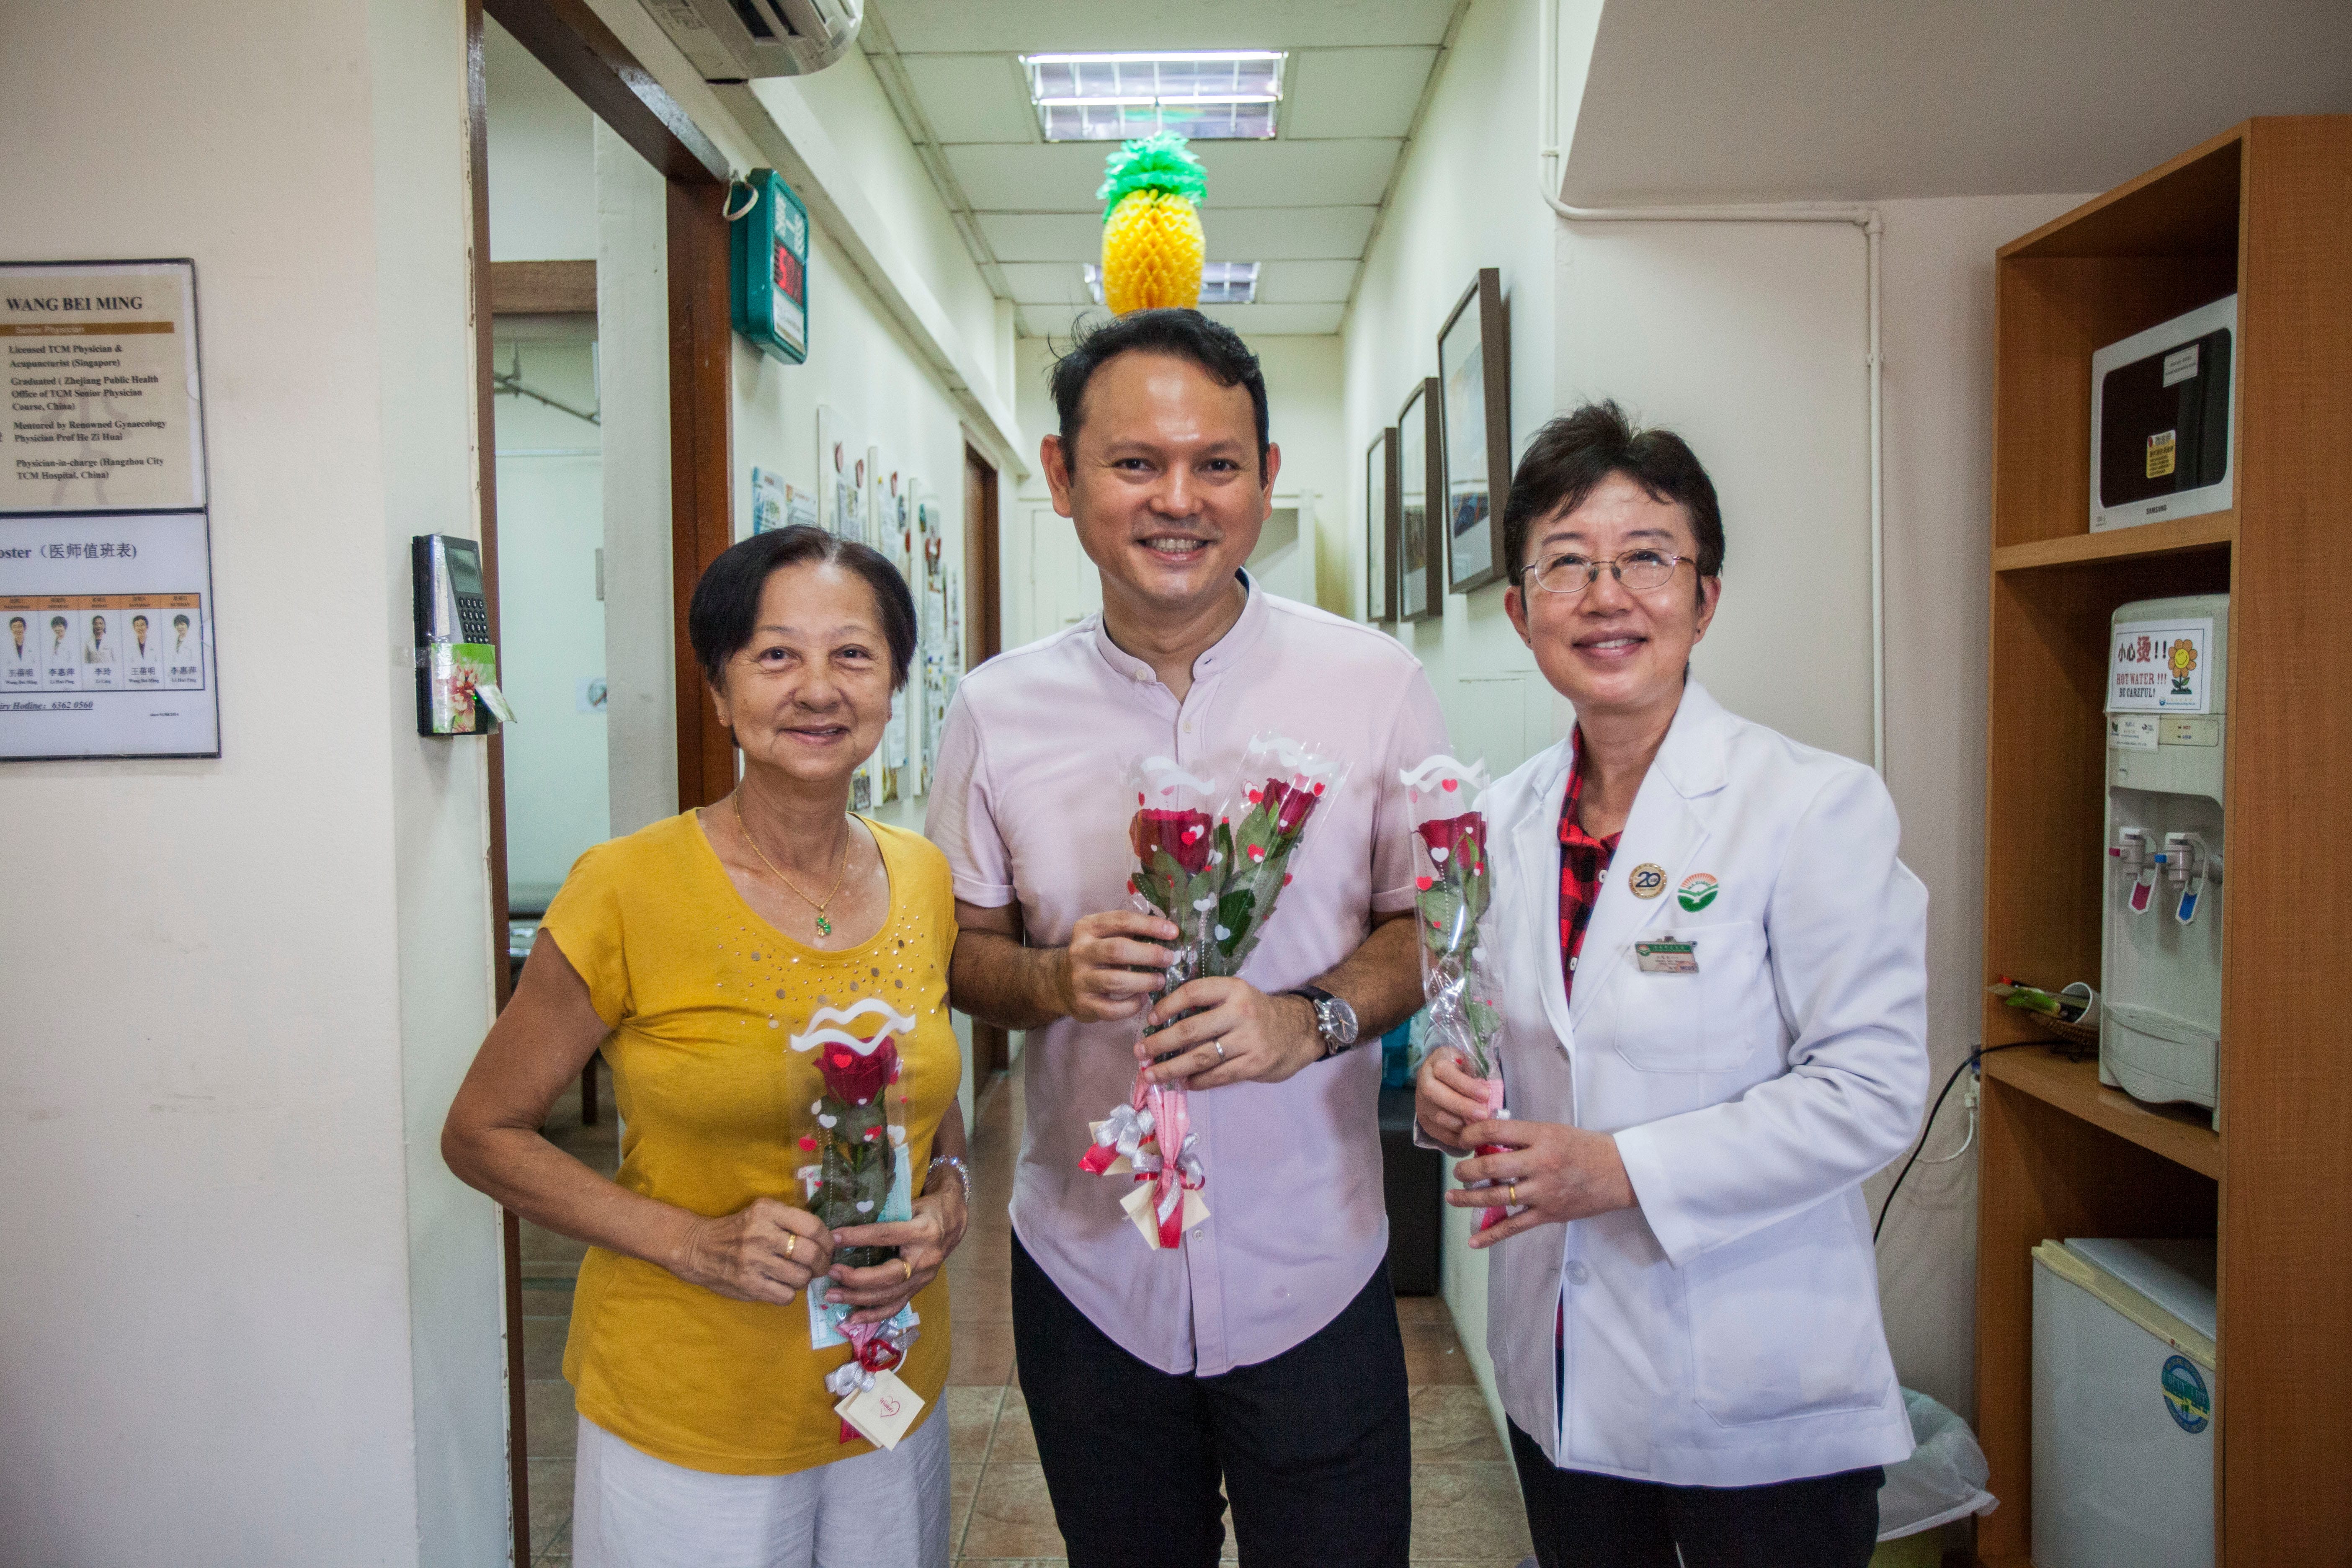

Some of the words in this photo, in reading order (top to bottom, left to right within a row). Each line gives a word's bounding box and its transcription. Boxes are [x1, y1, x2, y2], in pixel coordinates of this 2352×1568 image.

[6, 298, 58, 311] WANG
[63, 297, 91, 311] BEI
[97, 296, 142, 310] MING
[72, 345, 112, 355] Physician
[10, 359, 69, 369] Acupuncturist
[72, 359, 120, 369] (Singapore)
[64, 377, 101, 386] Zhejiang
[104, 388, 142, 398] Physician
[46, 402, 75, 410] China)
[13, 421, 54, 430] Mentored
[57, 421, 66, 431] by
[69, 420, 112, 429] Renowned
[114, 420, 166, 429] Gynaecology
[14, 434, 54, 443] Physician
[57, 433, 75, 442] Prof
[77, 433, 89, 441] He
[16, 459, 98, 469] Physician-in-charge
[100, 457, 144, 468] (Hangzhou
[146, 456, 165, 467] City
[17, 472, 39, 480] TCM
[80, 470, 111, 480] China)
[2146, 504, 2167, 514] SAMSUNG
[2117, 673, 2128, 685] HOT
[2130, 673, 2154, 685] WATER
[2157, 673, 2166, 685] !!!
[2119, 688, 2125, 697] BE
[2127, 688, 2155, 697] CAREFUL!
[1635, 872, 1661, 887] 20
